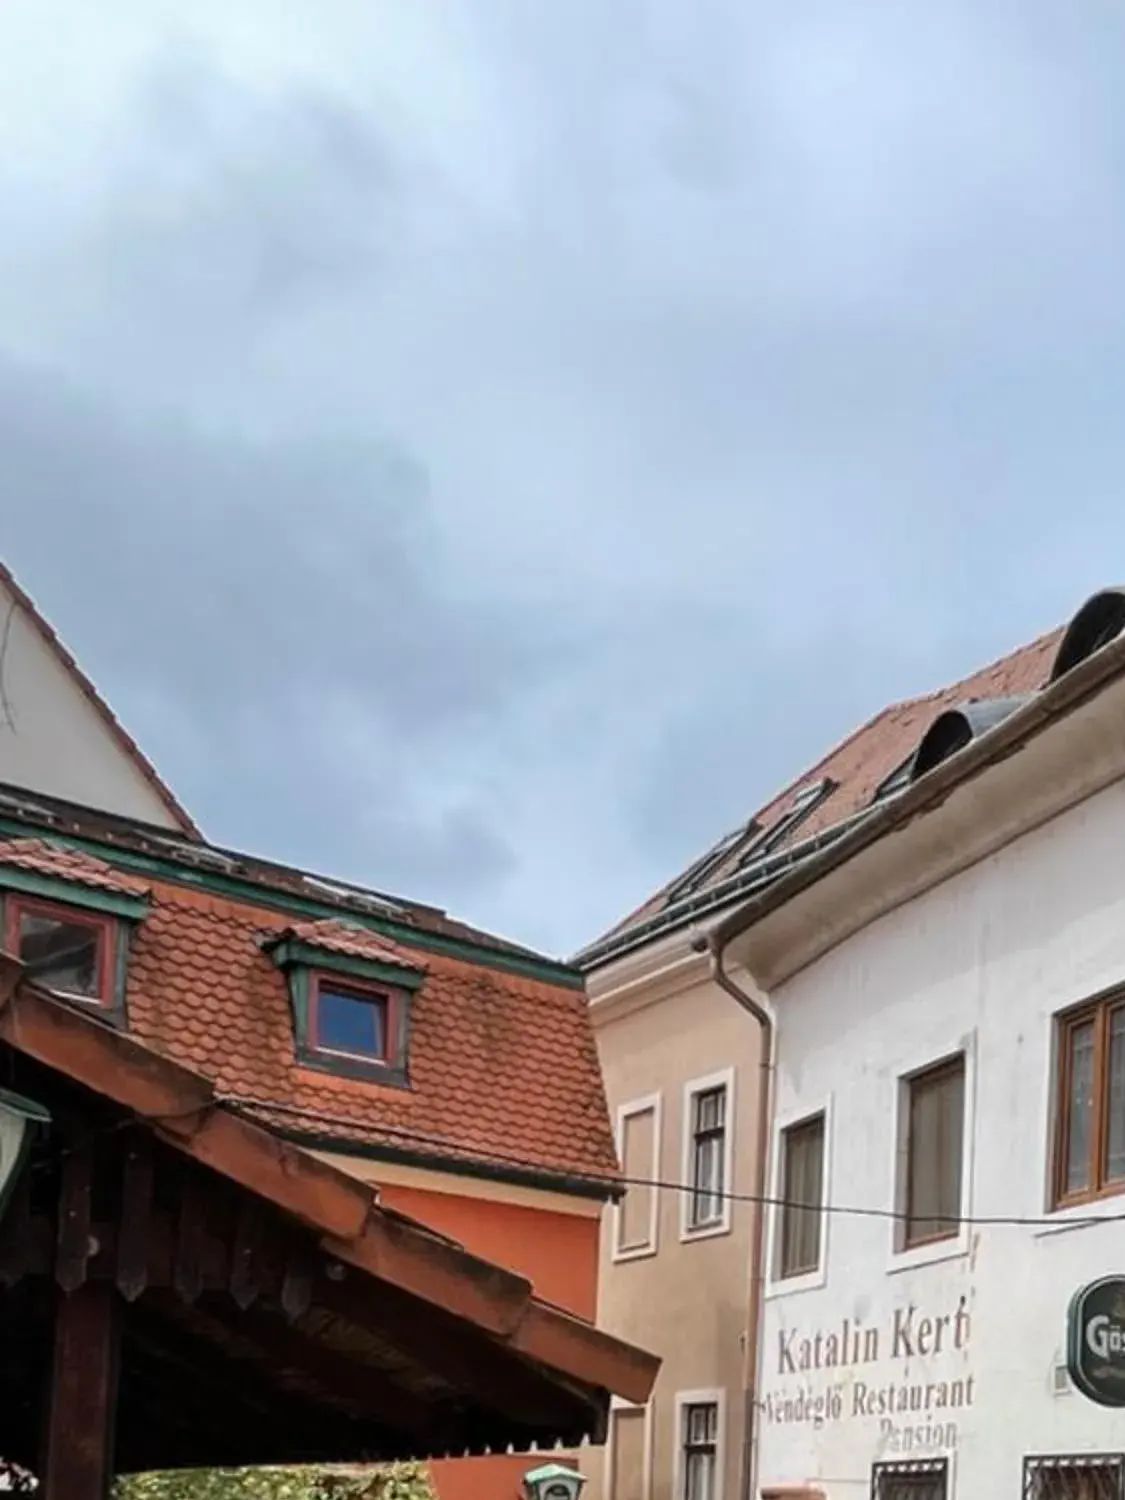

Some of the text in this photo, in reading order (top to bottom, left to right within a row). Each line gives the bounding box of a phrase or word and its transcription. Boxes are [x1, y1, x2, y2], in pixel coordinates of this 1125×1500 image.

[777, 1318, 879, 1375] Katalin
[851, 1375, 975, 1418] Restaurant
[878, 1413, 958, 1452] Pension
